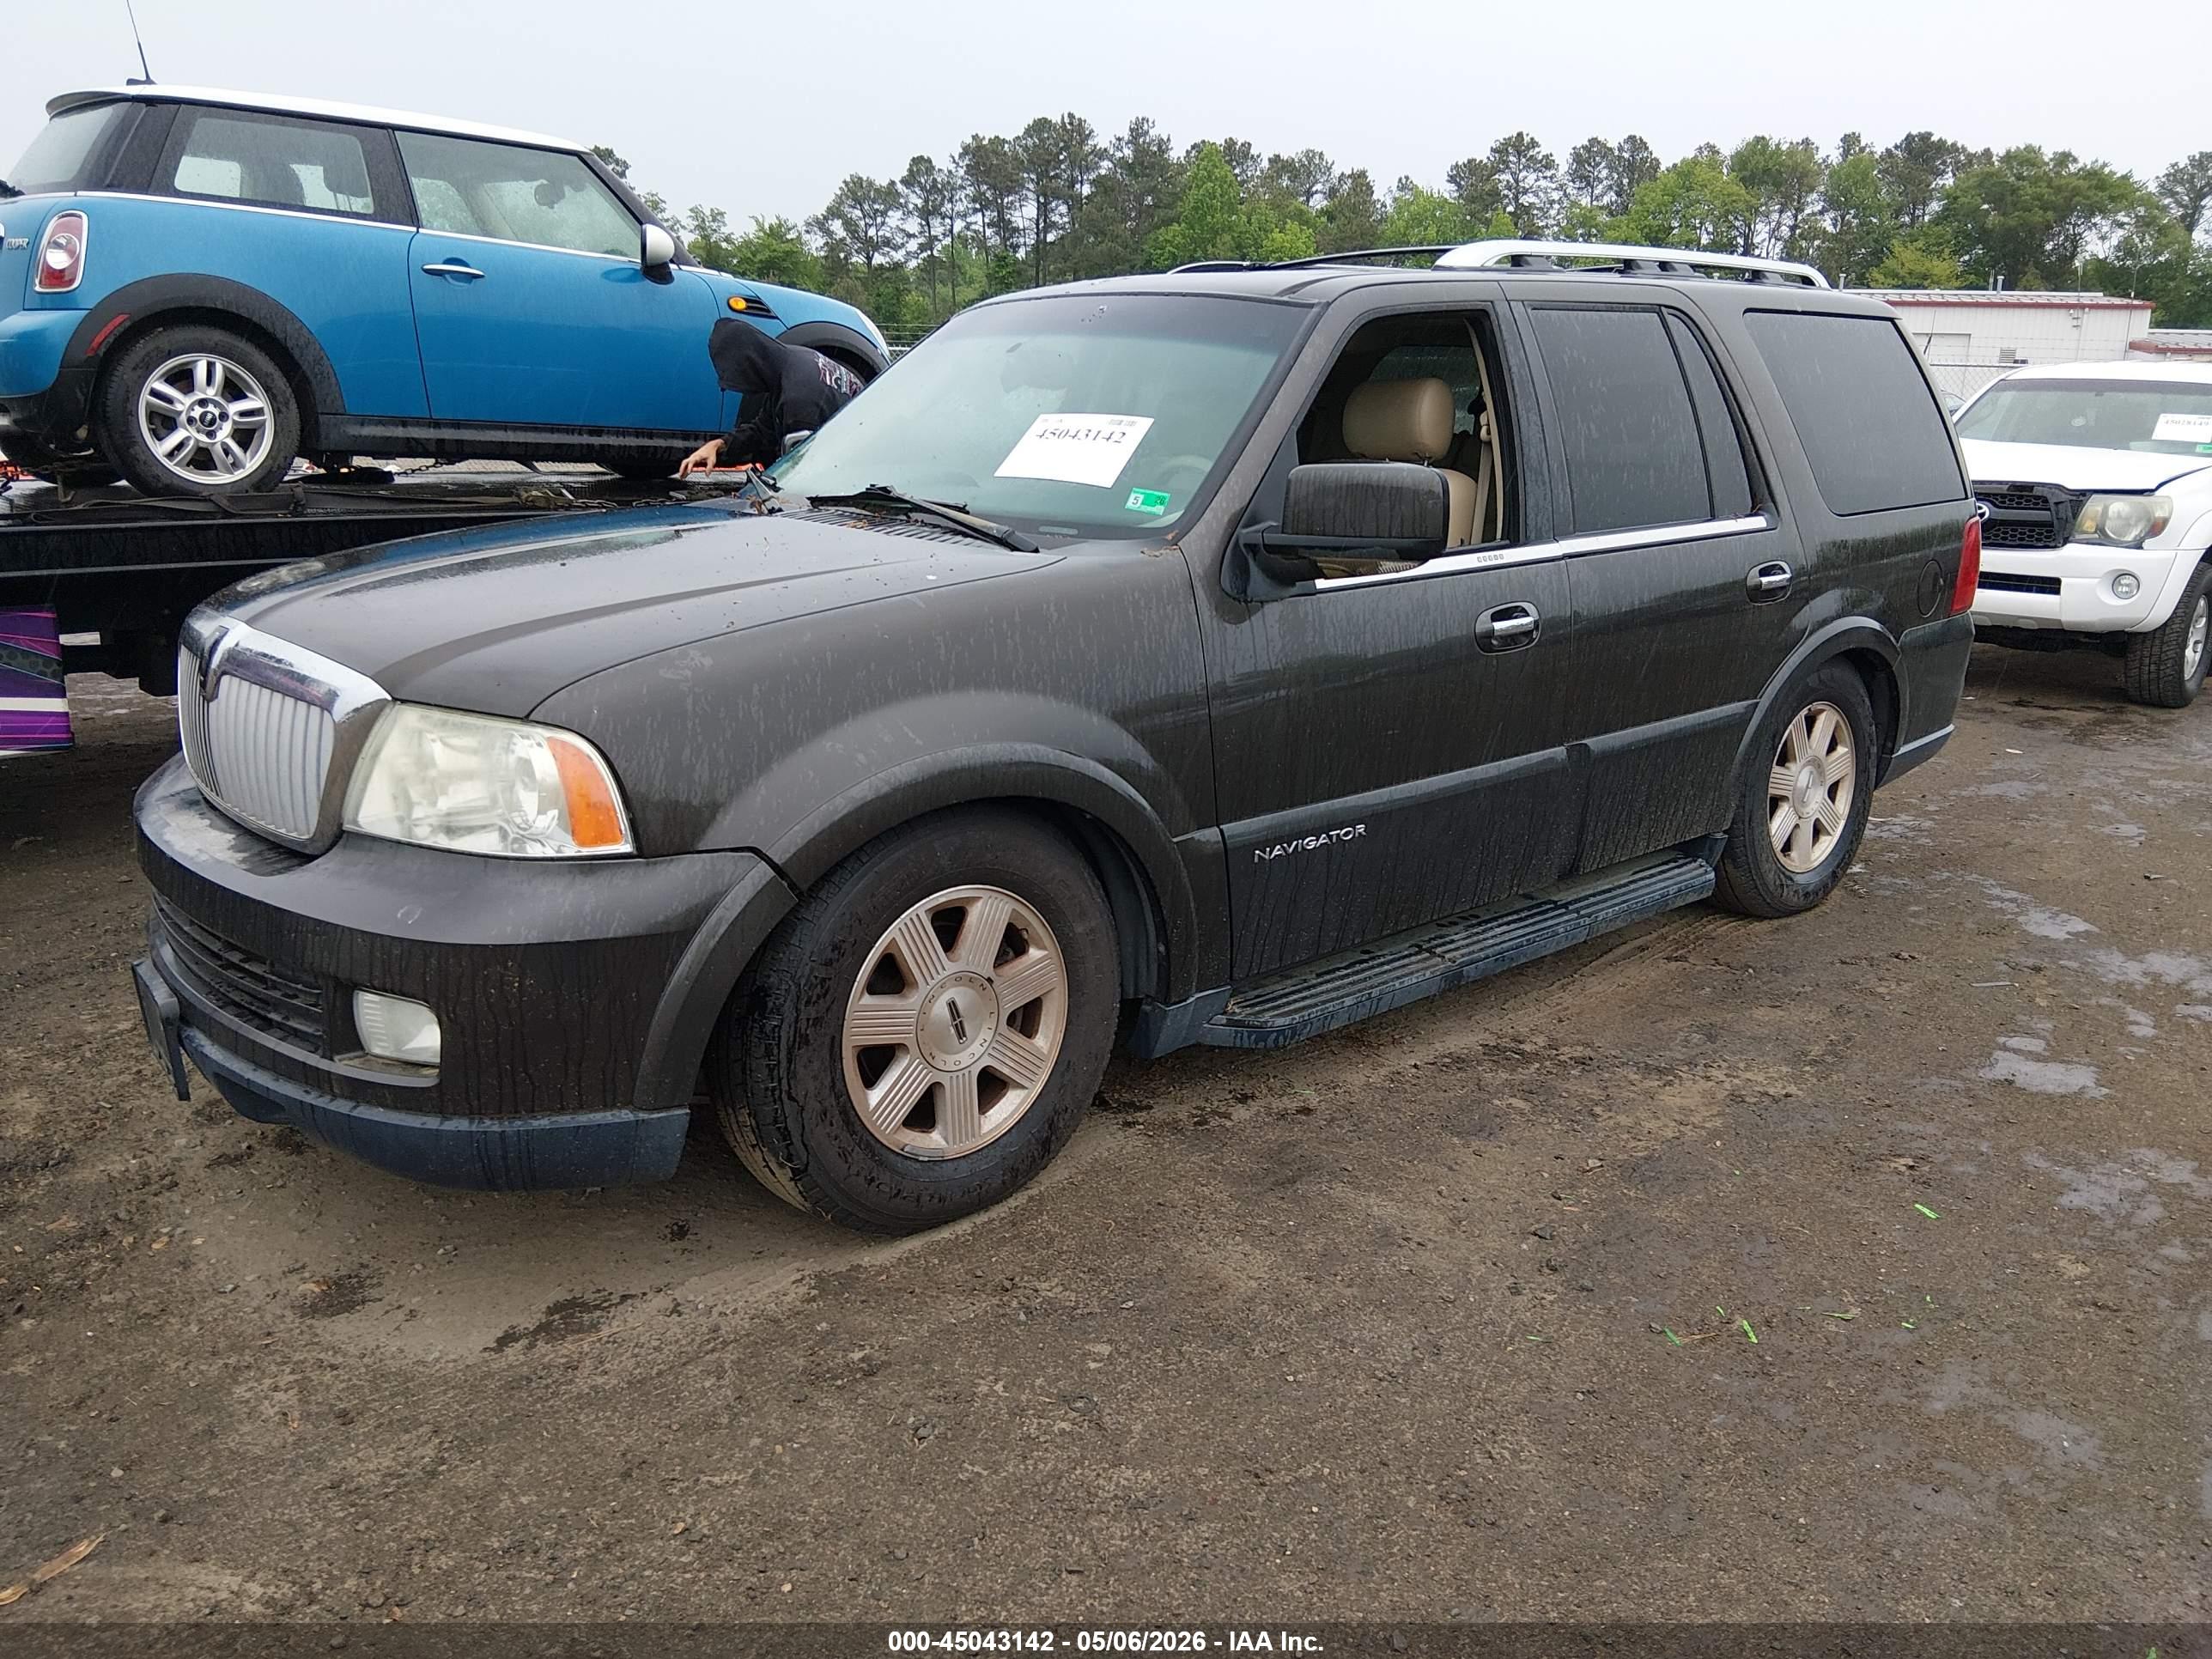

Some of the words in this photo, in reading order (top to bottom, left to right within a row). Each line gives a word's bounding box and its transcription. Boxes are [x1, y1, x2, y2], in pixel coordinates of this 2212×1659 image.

[1036, 428, 1126, 443] 45043142
[1132, 495, 1140, 505] 5
[1254, 823, 1367, 863] NAVIGATOR
[920, 976, 988, 1031] LINCOLN
[929, 1012, 995, 1066] LINCOLN
